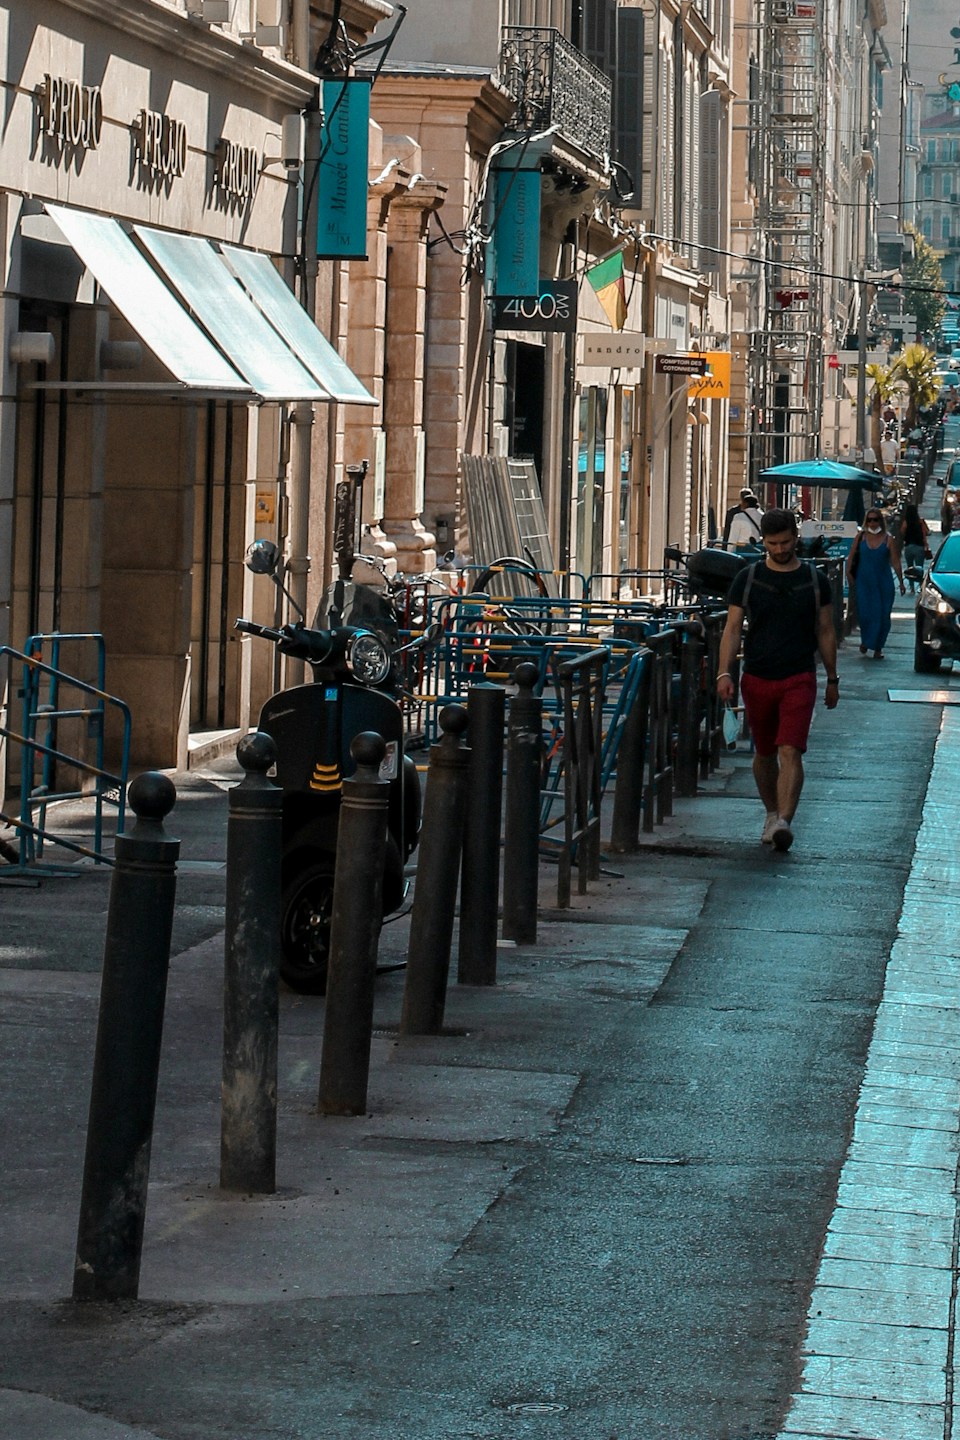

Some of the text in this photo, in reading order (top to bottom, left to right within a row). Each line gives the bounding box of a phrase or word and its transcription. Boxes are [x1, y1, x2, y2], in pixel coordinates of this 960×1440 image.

[44, 74, 102, 151] FROJO
[141, 109, 188, 178] FROJO
[330, 164, 349, 215] Musée
[503, 293, 557, 319] 400
[555, 293, 570, 319] M2
[588, 346, 641, 354] sandro
